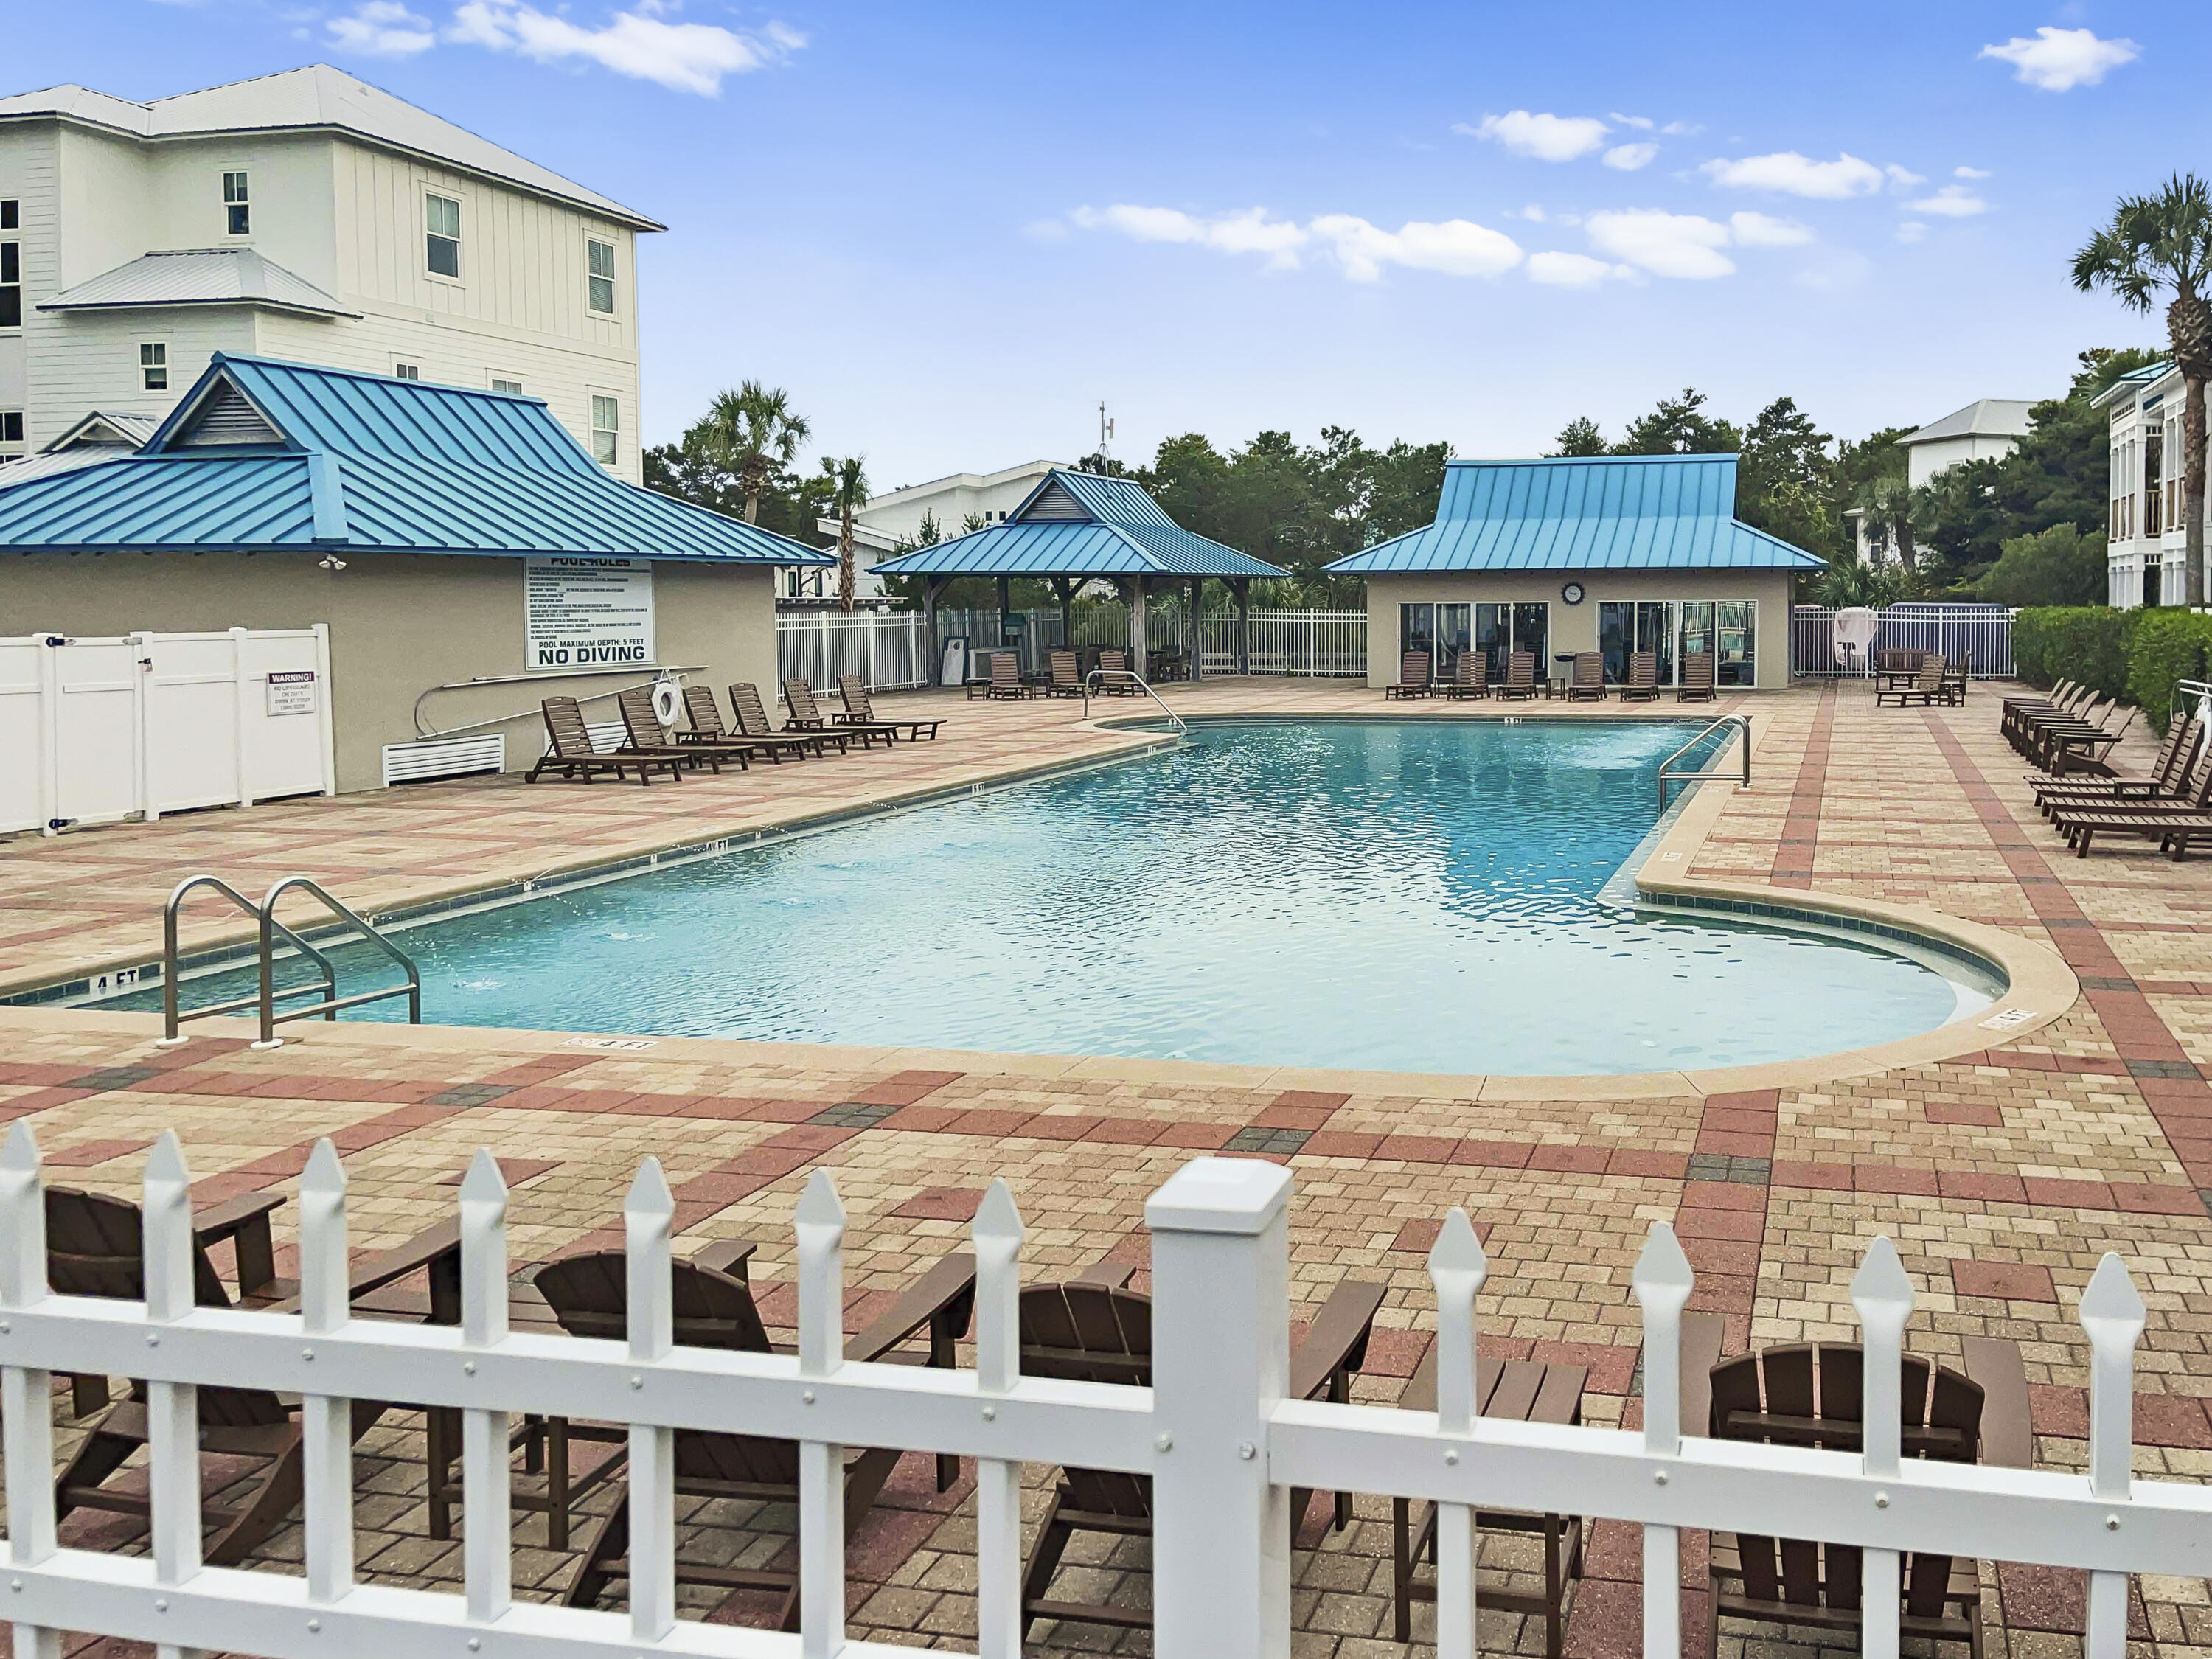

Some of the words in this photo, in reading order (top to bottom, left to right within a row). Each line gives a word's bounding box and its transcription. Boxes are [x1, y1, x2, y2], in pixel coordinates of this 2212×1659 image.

[551, 557, 586, 566] POOL
[591, 558, 630, 567] RULES
[539, 649, 569, 665] NO
[577, 646, 645, 663] DIVING
[271, 672, 312, 683] WARNING!
[116, 970, 137, 987] FT
